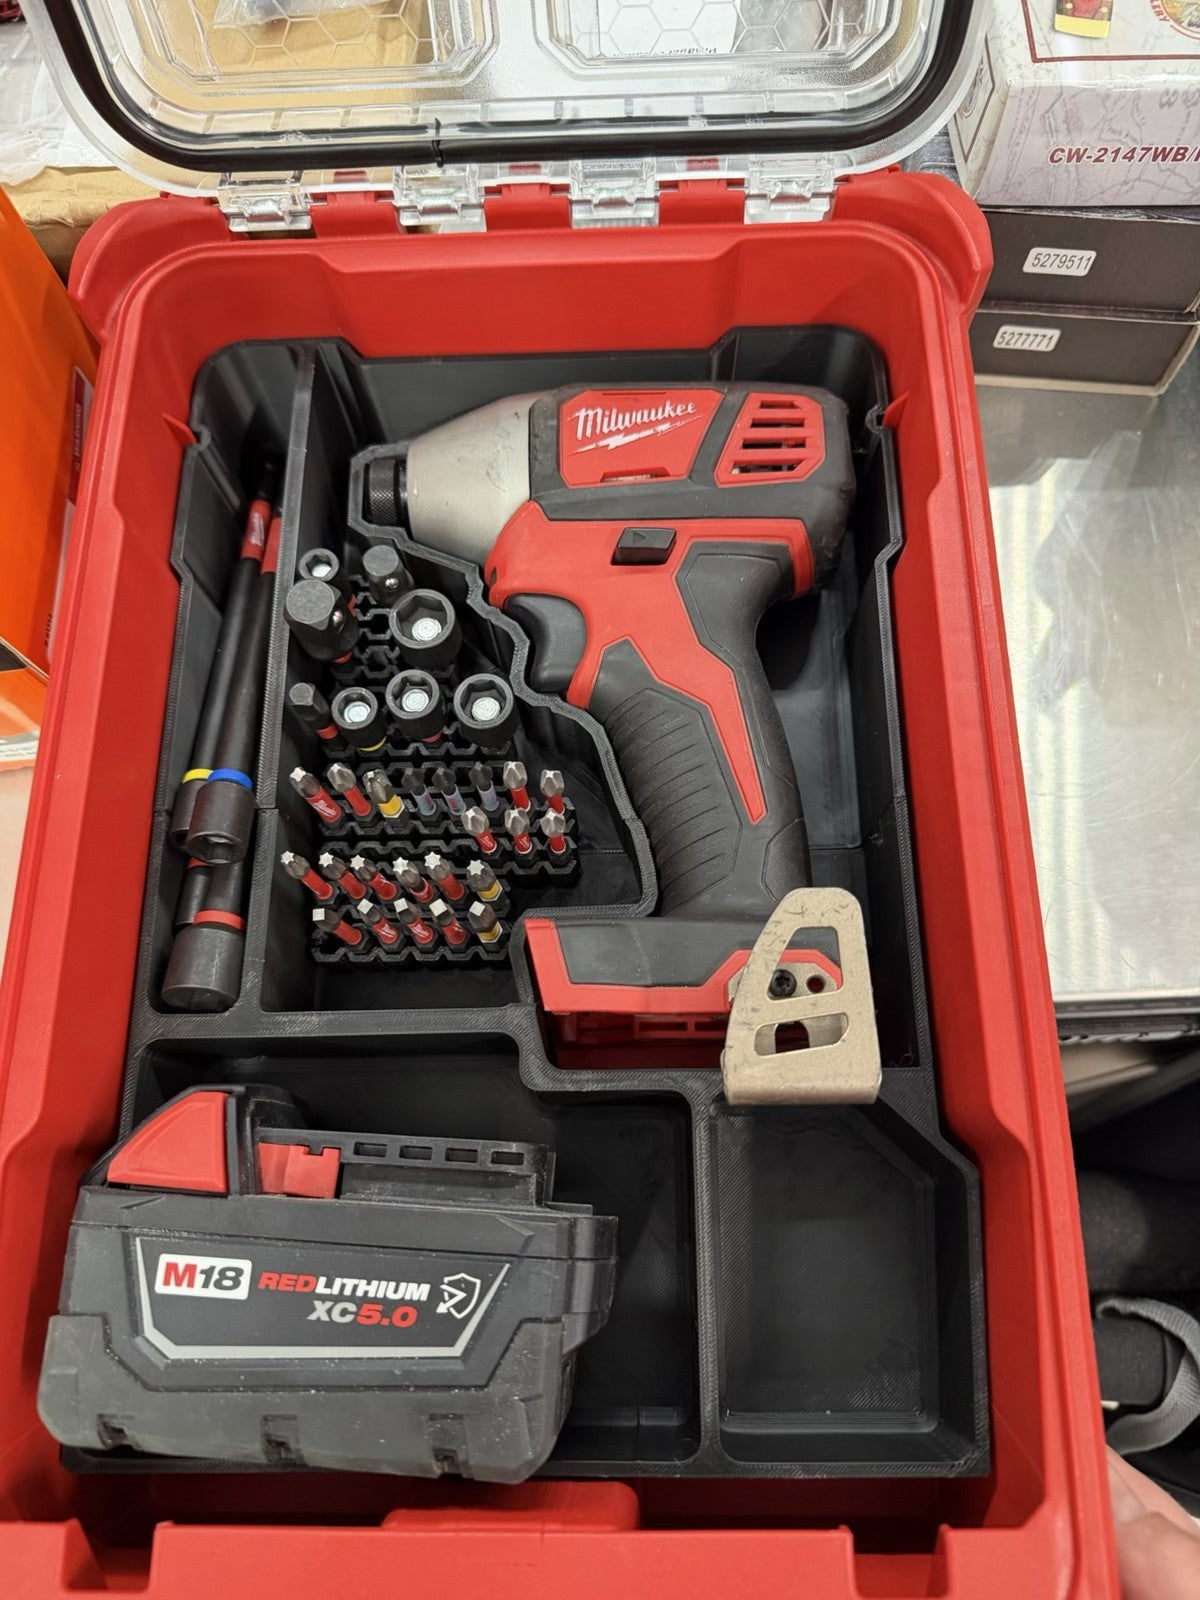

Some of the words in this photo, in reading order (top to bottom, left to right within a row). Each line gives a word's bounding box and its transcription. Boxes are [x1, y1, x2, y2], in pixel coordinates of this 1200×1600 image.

[1031, 252, 1092, 270] 5279511
[997, 331, 1054, 349] 5277771
[567, 400, 698, 441] Milwaukee
[162, 1261, 245, 1291] M18
[257, 1272, 431, 1302] REDLITHIUM
[307, 1300, 418, 1328] XC5.0
